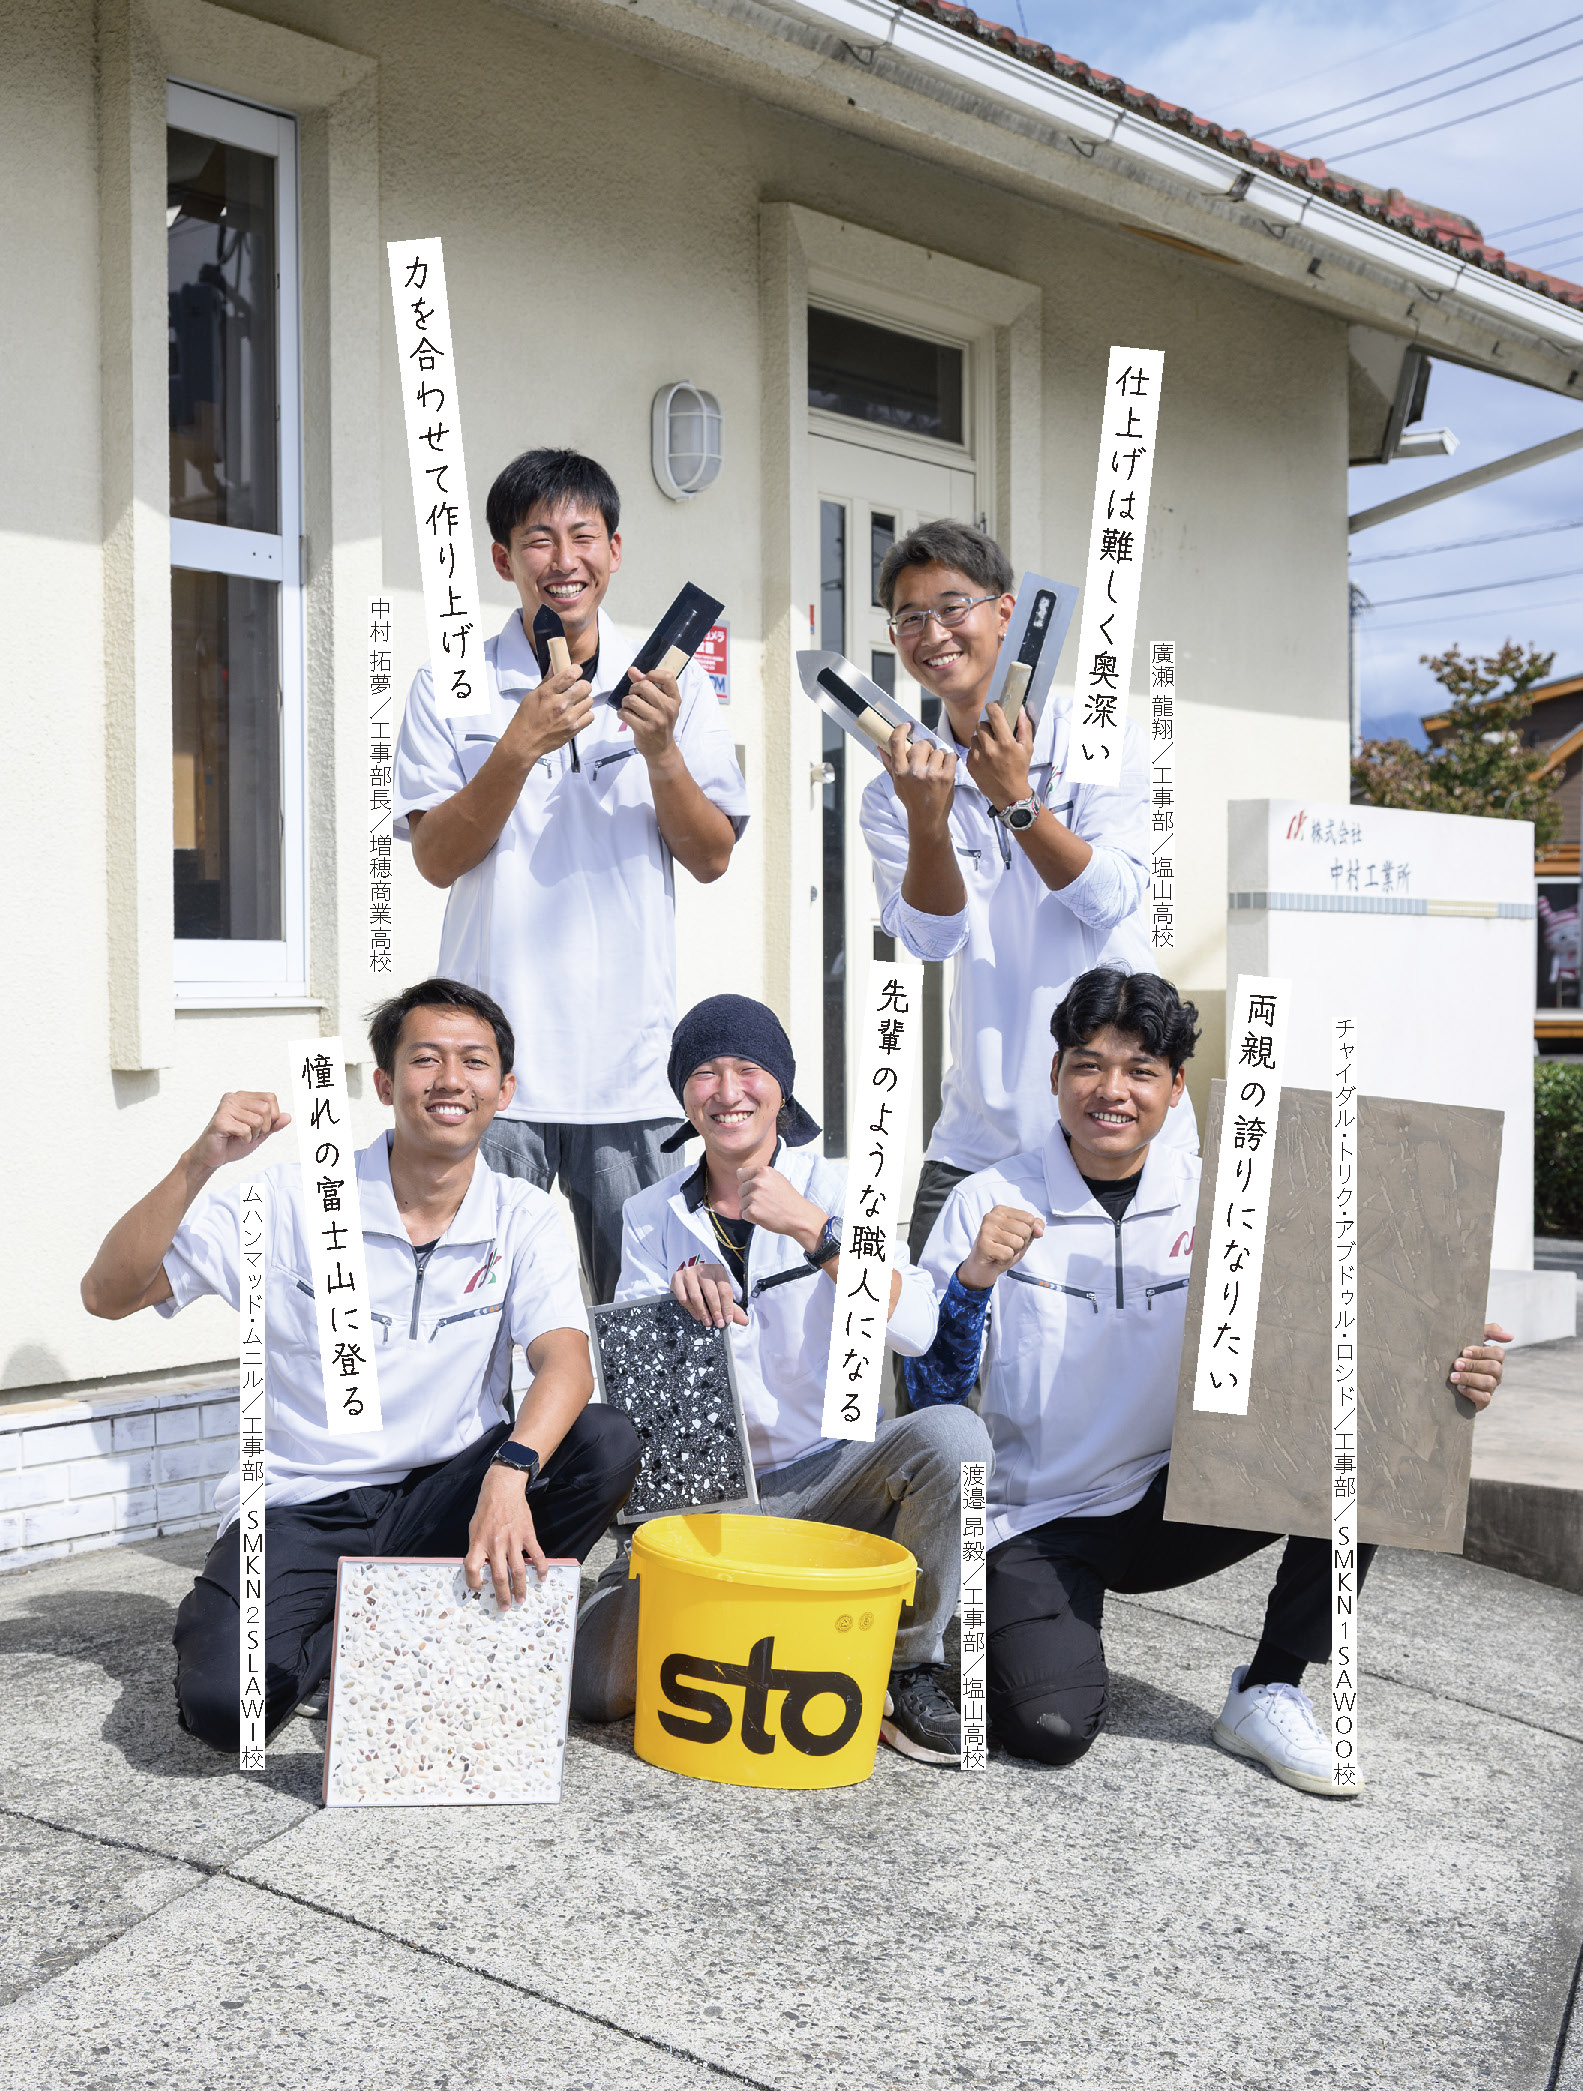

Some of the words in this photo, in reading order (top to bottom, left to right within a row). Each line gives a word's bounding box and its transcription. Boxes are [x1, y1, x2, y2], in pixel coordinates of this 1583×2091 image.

[1311, 818, 1363, 845] 株式会社
[1330, 857, 1411, 894] 中村工業所
[658, 1636, 863, 1757] sto
